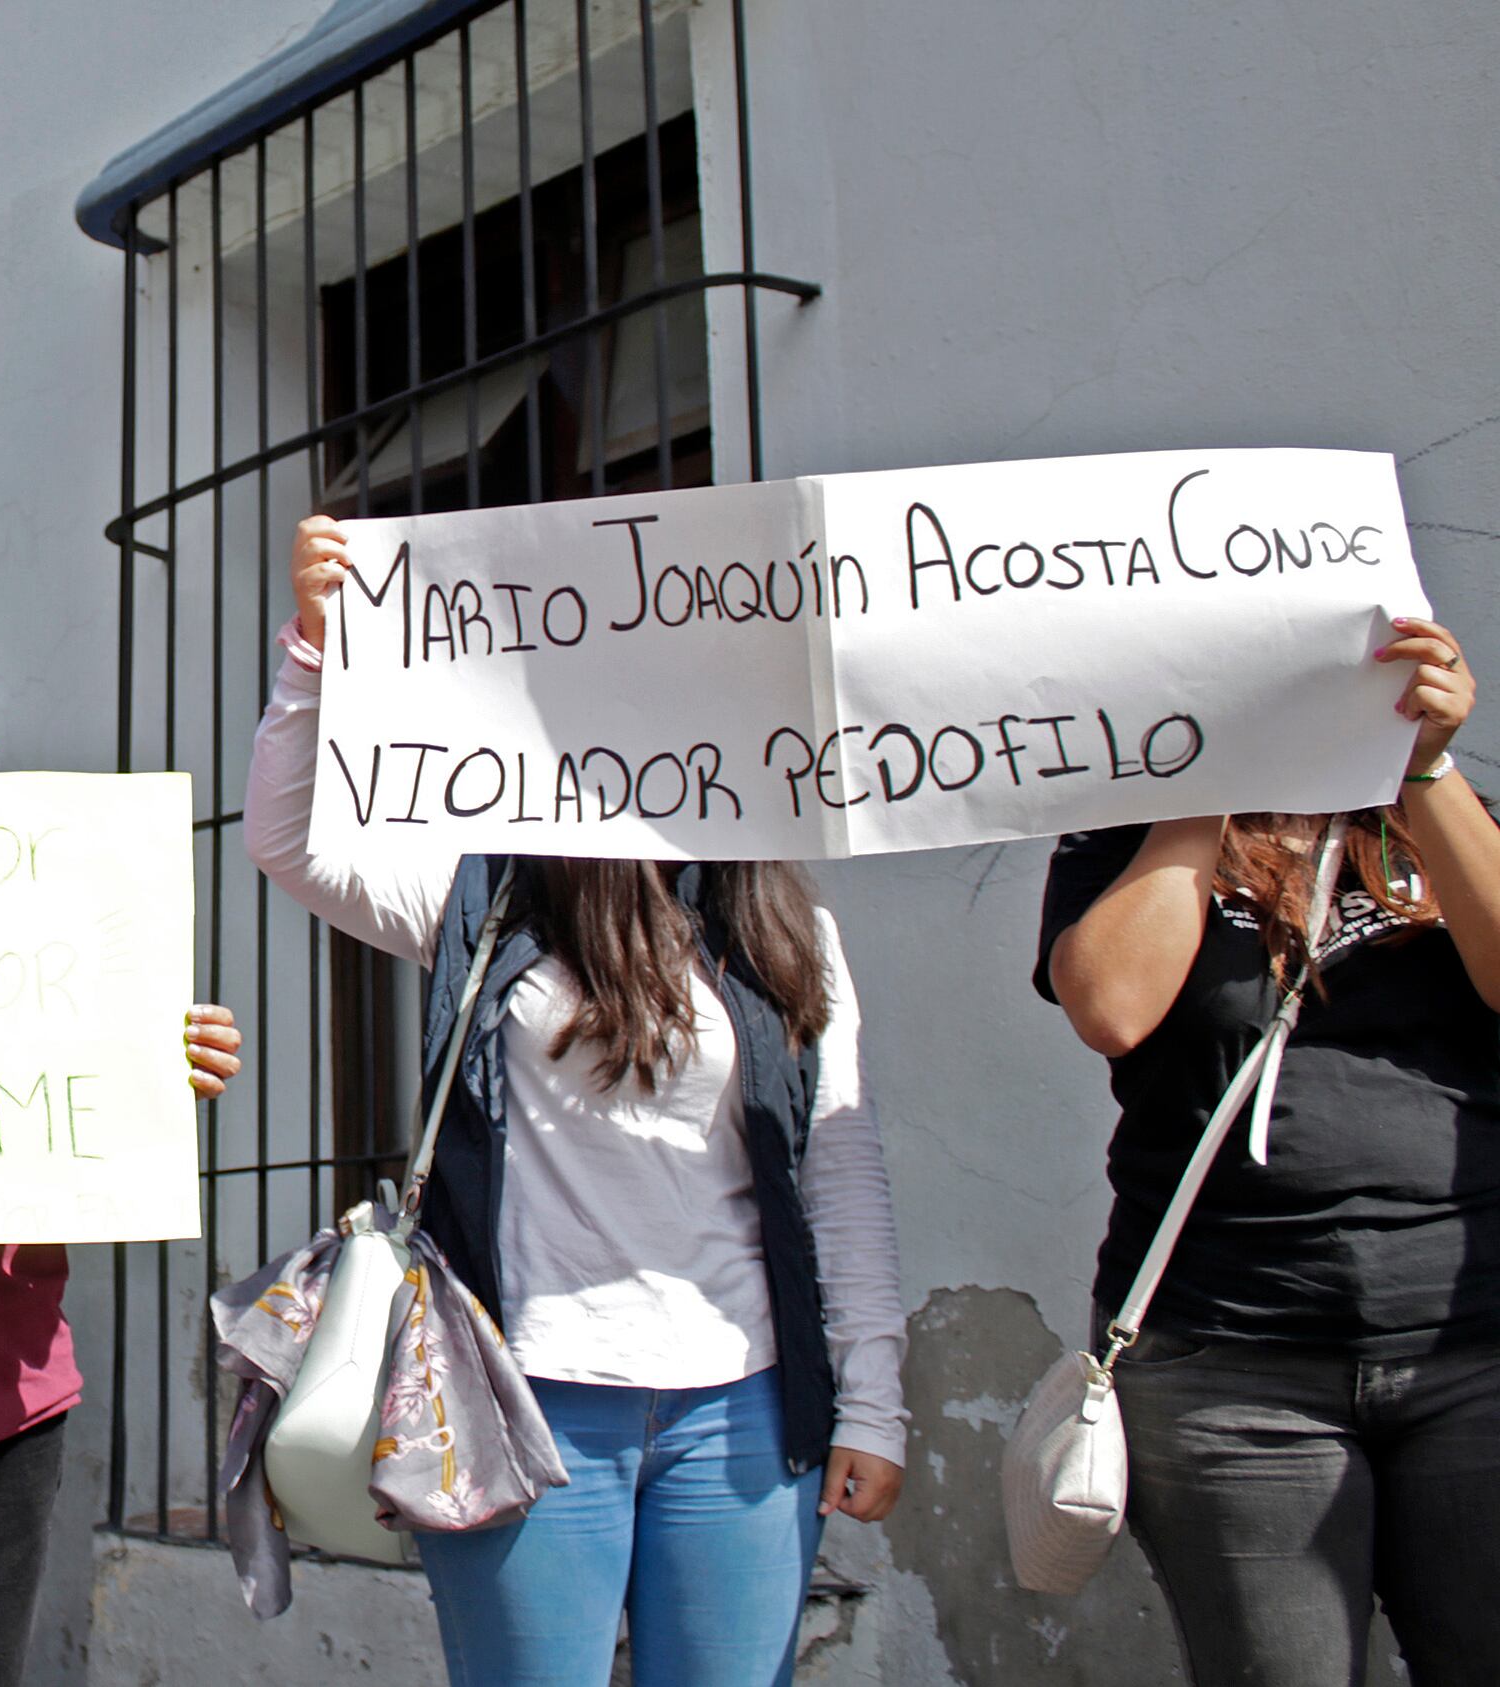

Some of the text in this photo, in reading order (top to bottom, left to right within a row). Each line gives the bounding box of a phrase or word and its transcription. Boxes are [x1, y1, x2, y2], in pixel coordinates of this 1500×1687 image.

[337, 541, 588, 670] MARIO
[906, 502, 1161, 609] ACOSTA
[1168, 469, 1384, 579] CONDE
[328, 738, 742, 827] VIOLADOR
